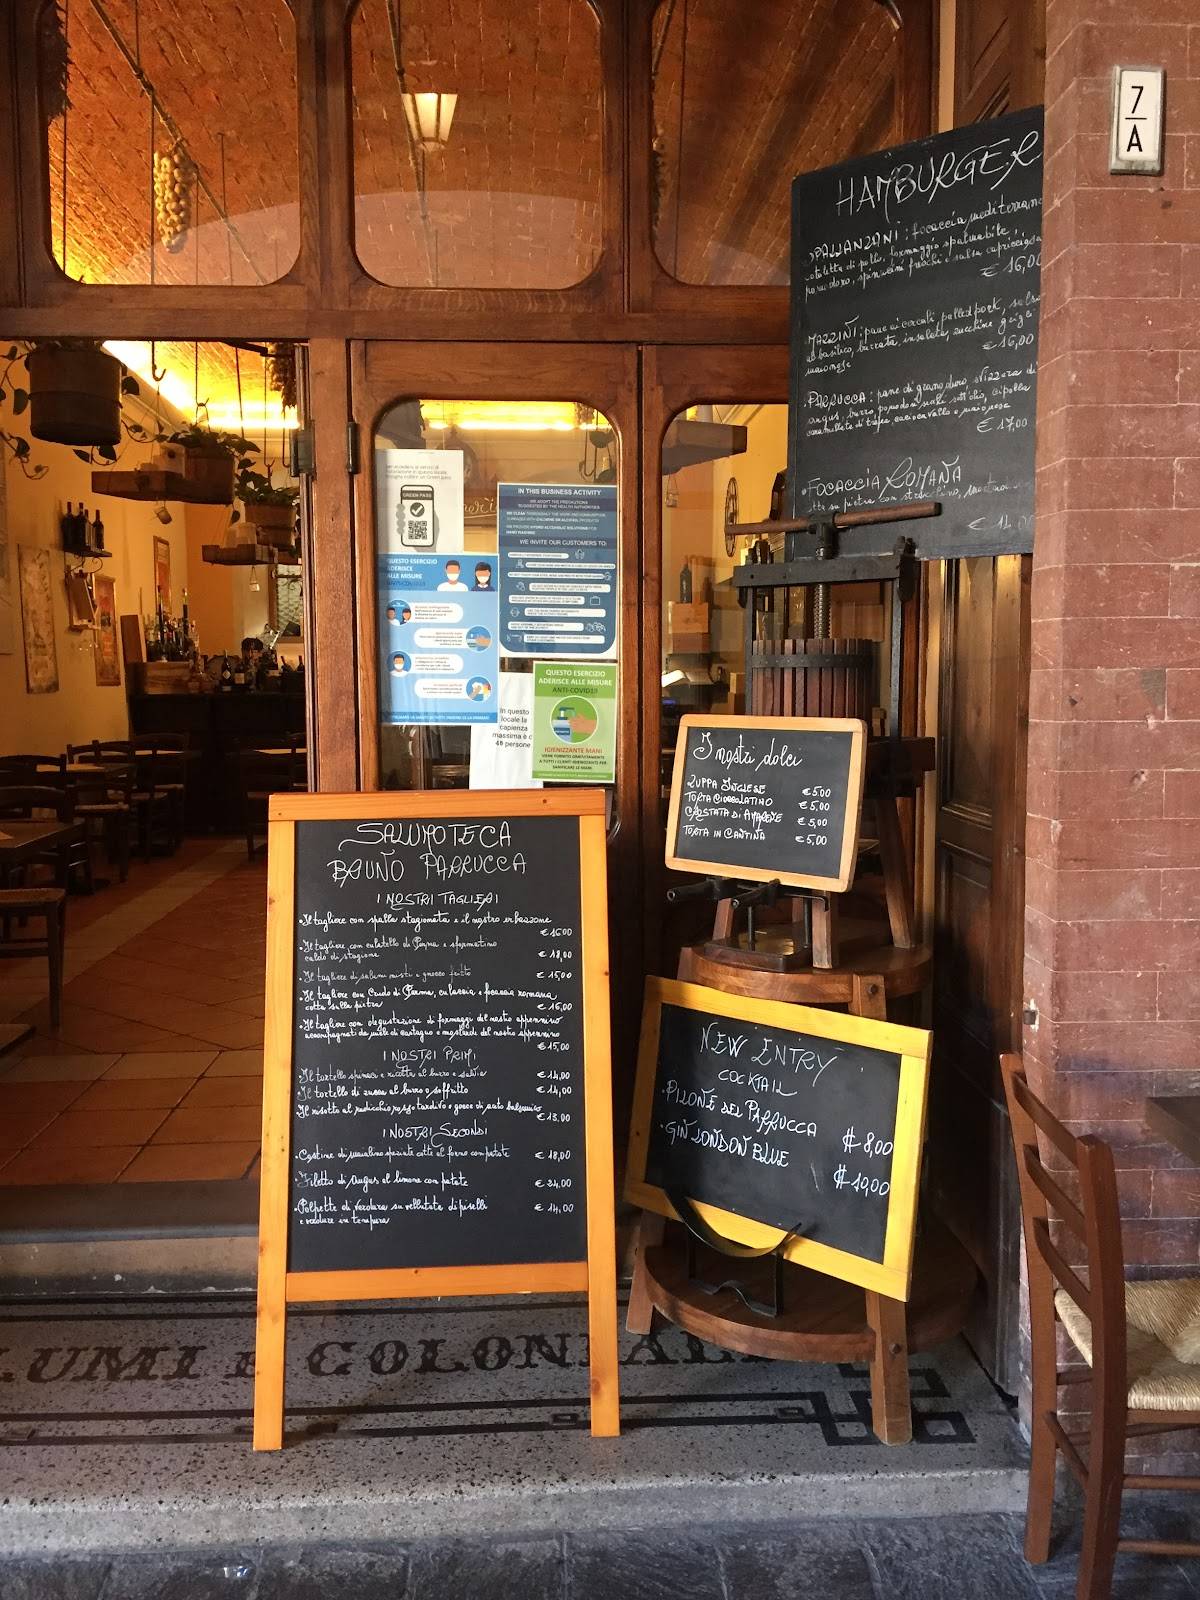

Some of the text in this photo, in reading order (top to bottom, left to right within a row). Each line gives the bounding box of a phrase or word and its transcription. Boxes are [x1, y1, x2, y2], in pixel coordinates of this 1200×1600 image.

[1131, 86, 1144, 114] 7
[1126, 124, 1143, 153] A
[836, 131, 1042, 222] HAMBURGER
[976, 415, 1028, 433] € 17,00
[806, 468, 881, 497] FOCACCIA
[878, 456, 963, 500] ROMANA
[518, 487, 525, 495] IN
[546, 669, 605, 678] QUESTO ESERCIZIO
[539, 677, 570, 685] ADERISCE
[571, 678, 586, 686] ALLE
[499, 725, 528, 733] capienza
[492, 732, 521, 740] massima
[505, 741, 531, 749] persone
[714, 733, 756, 770] nostri
[754, 737, 803, 772] dolci
[687, 774, 767, 795] ZUPPA INGLESE
[802, 786, 812, 796] €
[684, 791, 712, 811] TORTA
[798, 800, 808, 810] €
[797, 816, 828, 829] € 5,00
[338, 820, 512, 854] SALUMOTECA
[683, 824, 710, 838] TORTA
[723, 827, 766, 841] CANTINA
[795, 832, 828, 845] € 5,00
[326, 850, 527, 888] BRUNO PARRUCCA
[376, 890, 499, 911] I NOSTRI TAGLIERI
[540, 928, 549, 937] €
[538, 949, 573, 962] € 18,00
[536, 971, 573, 981] € 15,00
[537, 1001, 573, 1013] € 16,00
[537, 1041, 570, 1052] € 15,00
[391, 1049, 437, 1068] NOSTRI
[442, 1045, 476, 1067] PRIMI
[700, 1021, 838, 1087] NEW ENTRY
[537, 1070, 571, 1081] € 14,00
[717, 1068, 798, 1097] COCKTAIL
[536, 1084, 572, 1098] € 14,00
[666, 1078, 817, 1137] PILONE DEL PARRUCCA
[537, 1112, 546, 1121] €
[389, 1122, 433, 1141] NOSTRI
[431, 1119, 488, 1147] SECONDI
[664, 1118, 790, 1168] GIN LONDON BLUE
[862, 1131, 893, 1158] 8,00
[534, 1150, 571, 1163] € 18,00
[534, 1179, 545, 1187] €
[534, 1203, 574, 1215] € 14,00
